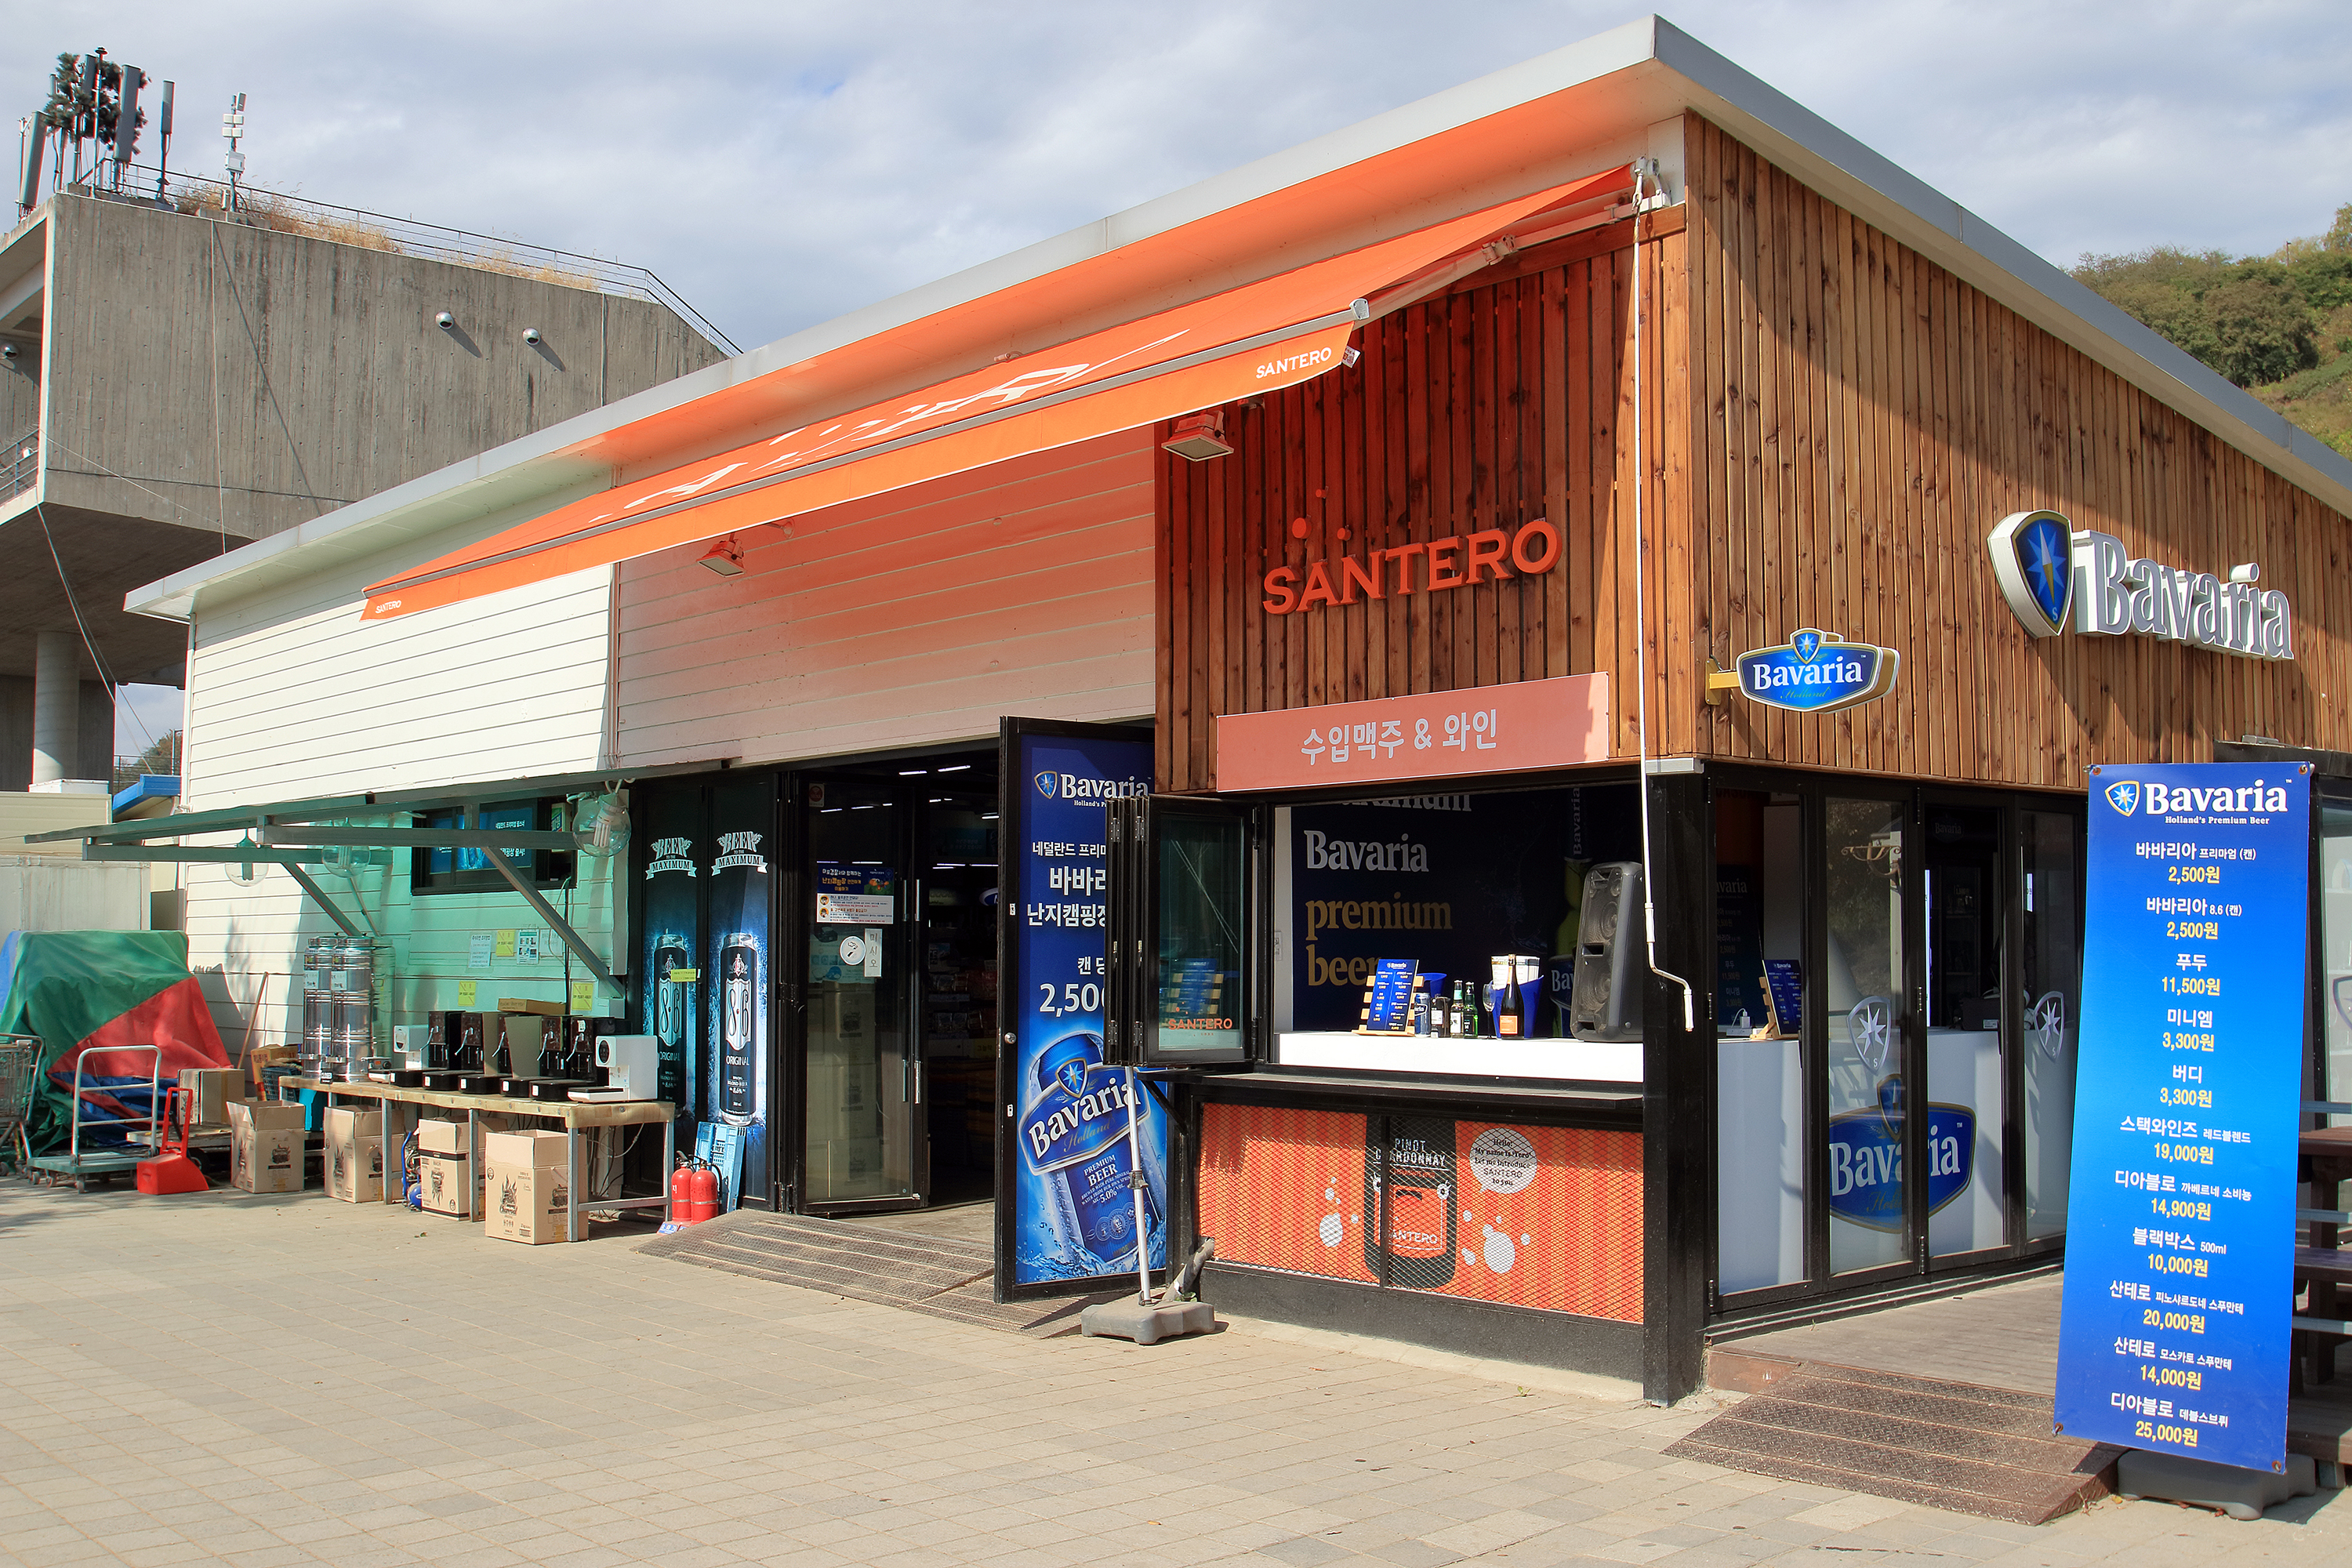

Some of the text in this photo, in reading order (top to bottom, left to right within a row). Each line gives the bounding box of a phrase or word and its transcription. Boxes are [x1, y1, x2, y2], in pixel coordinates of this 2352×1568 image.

[1256, 347, 1332, 379] SANTERO
[1263, 521, 1563, 615] SANTERO
[2074, 529, 2295, 660] Bavaria
[376, 600, 402, 614] SANTERO
[1752, 655, 1864, 690] Bavaria
[1301, 709, 1497, 766] 수입맥주 & 와인
[1061, 773, 1149, 799] Bavaria
[2144, 779, 2288, 815] Bavaria
[1573, 786, 1581, 855] Bavaria
[1935, 822, 1962, 834] Bavaria
[2165, 815, 2270, 825] Holland's Premium Beer
[655, 837, 688, 860] BEER
[722, 831, 757, 855] BEER
[1033, 840, 1076, 858] 네덜란드
[1304, 829, 1429, 873] Bavaria
[2136, 841, 2198, 861] 바바리아
[2239, 848, 2257, 861] (캔)
[652, 859, 691, 871] MAXIMUM
[718, 855, 761, 866] MAXIMUM
[2168, 866, 2220, 885] 2,500원
[1305, 891, 1453, 941] premium
[2146, 896, 2242, 916] 바바리아 8.6 (캔)
[2166, 920, 2219, 941] 2,500원
[869, 932, 878, 968] 미시오
[1077, 956, 1092, 976] 캔
[1305, 943, 1381, 986] beer
[2176, 953, 2208, 972] 푸두
[2161, 975, 2221, 996] 11,500원
[1040, 983, 1105, 1018] 2,50
[1168, 1018, 1233, 1030] SANTERO
[2166, 1008, 2213, 1029] 미니엠
[2161, 1032, 2215, 1052] 3,300원
[659, 1051, 681, 1062] ORIGINAL
[726, 1055, 750, 1066] ORIGINAL
[2172, 1064, 2202, 1084] 버디
[2160, 1087, 2212, 1109] 3,300원
[1028, 1076, 1142, 1160] Bavaria
[2119, 1115, 2252, 1143] 스택와인즈 레드블렌드
[1063, 1114, 1116, 1152] Holland
[1394, 1138, 1426, 1152] PINOT
[1083, 1154, 1116, 1176] PREMIUM
[1375, 1149, 1446, 1167] CARDONNAY
[1829, 1124, 1961, 1196] Bavia
[2154, 1142, 2214, 1165] 19,000원
[1087, 1163, 1119, 1187] BEER
[1483, 1167, 1523, 1178] SANTERO
[1099, 1188, 1118, 1203] 5.0%
[2114, 1170, 2252, 1202] 디아블로 까베르네 소비뇽
[2151, 1197, 2212, 1221] 14,900원
[2132, 1226, 2227, 1255] 블랙박스 500ml
[2147, 1253, 2209, 1278] 10,000원
[2109, 1279, 2245, 1316] 산테로 피노샤르도네 스푸만테
[2143, 1308, 2205, 1334] 20,000원
[2113, 1336, 2233, 1371] 산테로 모스카토 스푸만테
[2140, 1364, 2202, 1391] 14,000원
[2111, 1391, 2174, 1418] 디아블로
[2135, 1420, 2198, 1448] 25,000원
